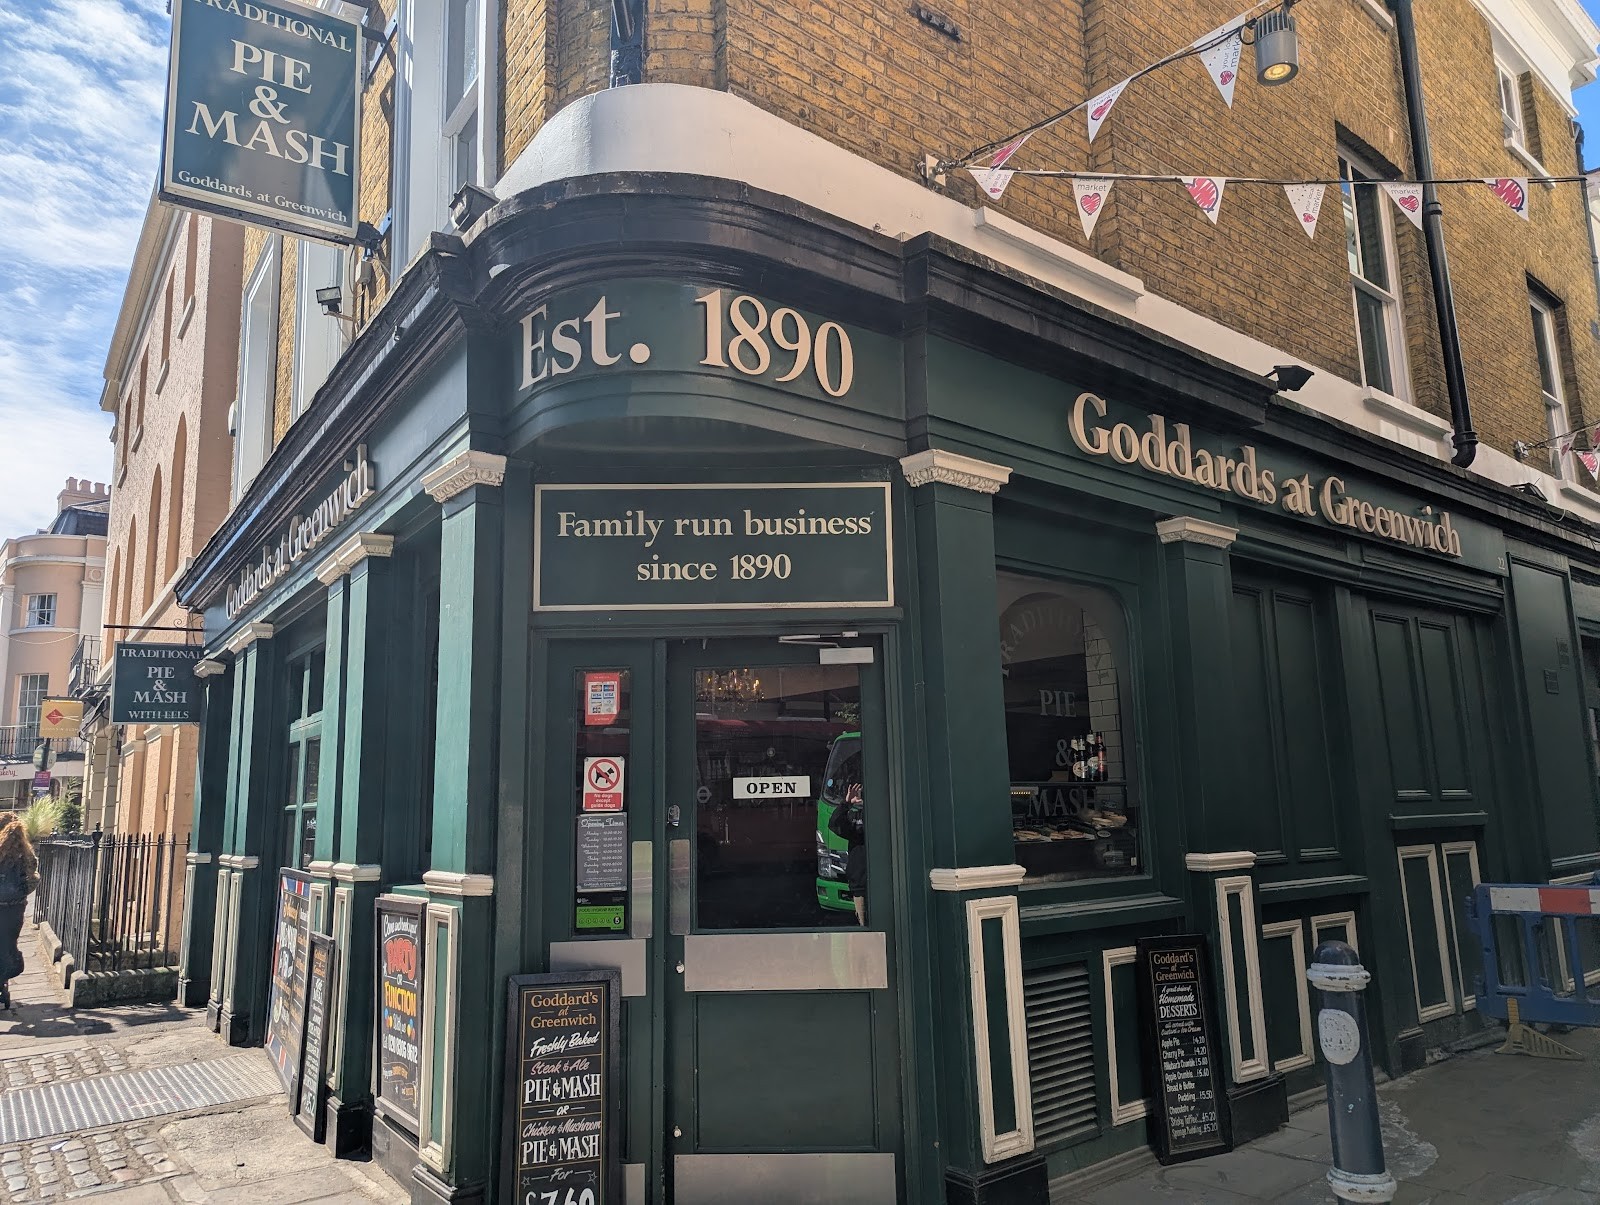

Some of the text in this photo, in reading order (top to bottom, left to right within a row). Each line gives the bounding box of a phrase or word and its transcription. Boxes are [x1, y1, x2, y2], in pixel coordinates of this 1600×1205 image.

[194, 0, 351, 52] RADITIONAL
[1231, 33, 1242, 67] marke
[230, 39, 312, 94] PIE
[249, 85, 291, 124] &
[185, 100, 350, 177] MASH
[1077, 184, 1108, 192] market
[178, 170, 347, 223] Goddards at Greenwich
[518, 289, 854, 397] Est. 1890
[1068, 392, 1463, 558] Goddards at Greenwich
[225, 443, 376, 621] Goddards at Greenwich
[557, 508, 873, 547] Family run business
[637, 553, 792, 581] since 1890
[147, 666, 175, 679] PIE
[153, 679, 167, 691] &
[133, 691, 188, 704] MASH
[1039, 689, 1077, 718] PIE
[128, 710, 189, 719] WITH EELS
[1055, 739, 1075, 769] &
[746, 782, 797, 794] OPEN
[1027, 787, 1097, 819] MASH
[581, 818, 624, 829] Opening Times
[386, 937, 417, 981] PARTY
[1154, 952, 1193, 965] Goddard's
[1155, 969, 1195, 981] Greenwich
[385, 981, 417, 1017] FUNCTION
[531, 992, 599, 1008] Goddard's
[1159, 992, 1195, 1004] Homemade
[558, 1006, 569, 1016] at
[1159, 1003, 1198, 1018] DESSERTS
[531, 1013, 596, 1028] Greenwich
[530, 1031, 600, 1057] Freshly Baked
[1161, 1038, 1173, 1049] Apple
[1162, 1050, 1178, 1060] Cherry
[1177, 1049, 1185, 1057] Pie
[531, 1060, 562, 1075] Steak
[569, 1058, 590, 1072] Ale
[1165, 1072, 1177, 1083] Apple
[1177, 1070, 1193, 1079] Crumble
[524, 1073, 601, 1104] PIE & MASH
[1166, 1082, 1179, 1092] Bread
[1183, 1081, 1195, 1090] Butter
[1177, 1092, 1196, 1102] Pudding
[556, 1105, 570, 1116] OR
[1169, 1104, 1189, 1115] Chocolate
[522, 1120, 556, 1138] Chicken
[562, 1117, 602, 1133] Mushroom
[521, 1134, 600, 1165] PIE & MASH
[550, 1168, 574, 1182] For
